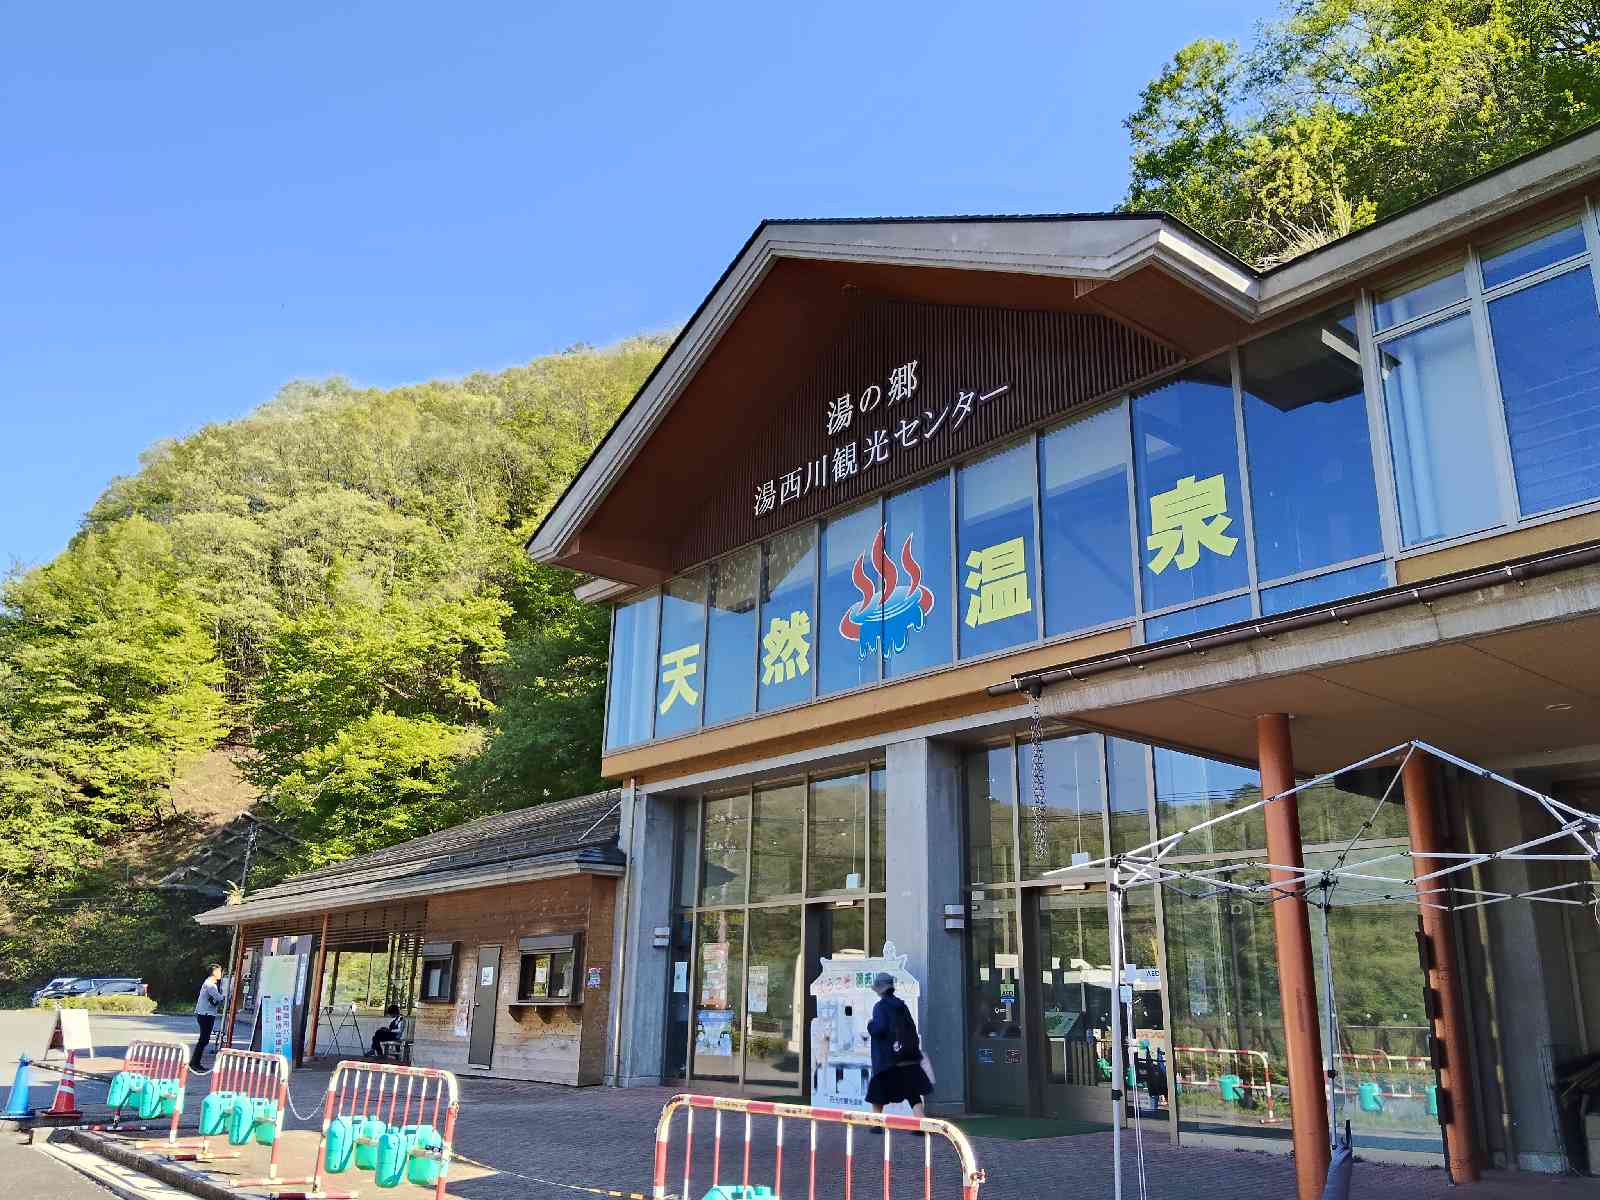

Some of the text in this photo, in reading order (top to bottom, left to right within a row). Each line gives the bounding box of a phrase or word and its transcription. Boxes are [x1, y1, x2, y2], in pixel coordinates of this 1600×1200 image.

[826, 360, 918, 435] 湯の郷
[754, 385, 1009, 516] 湯西川観光センター
